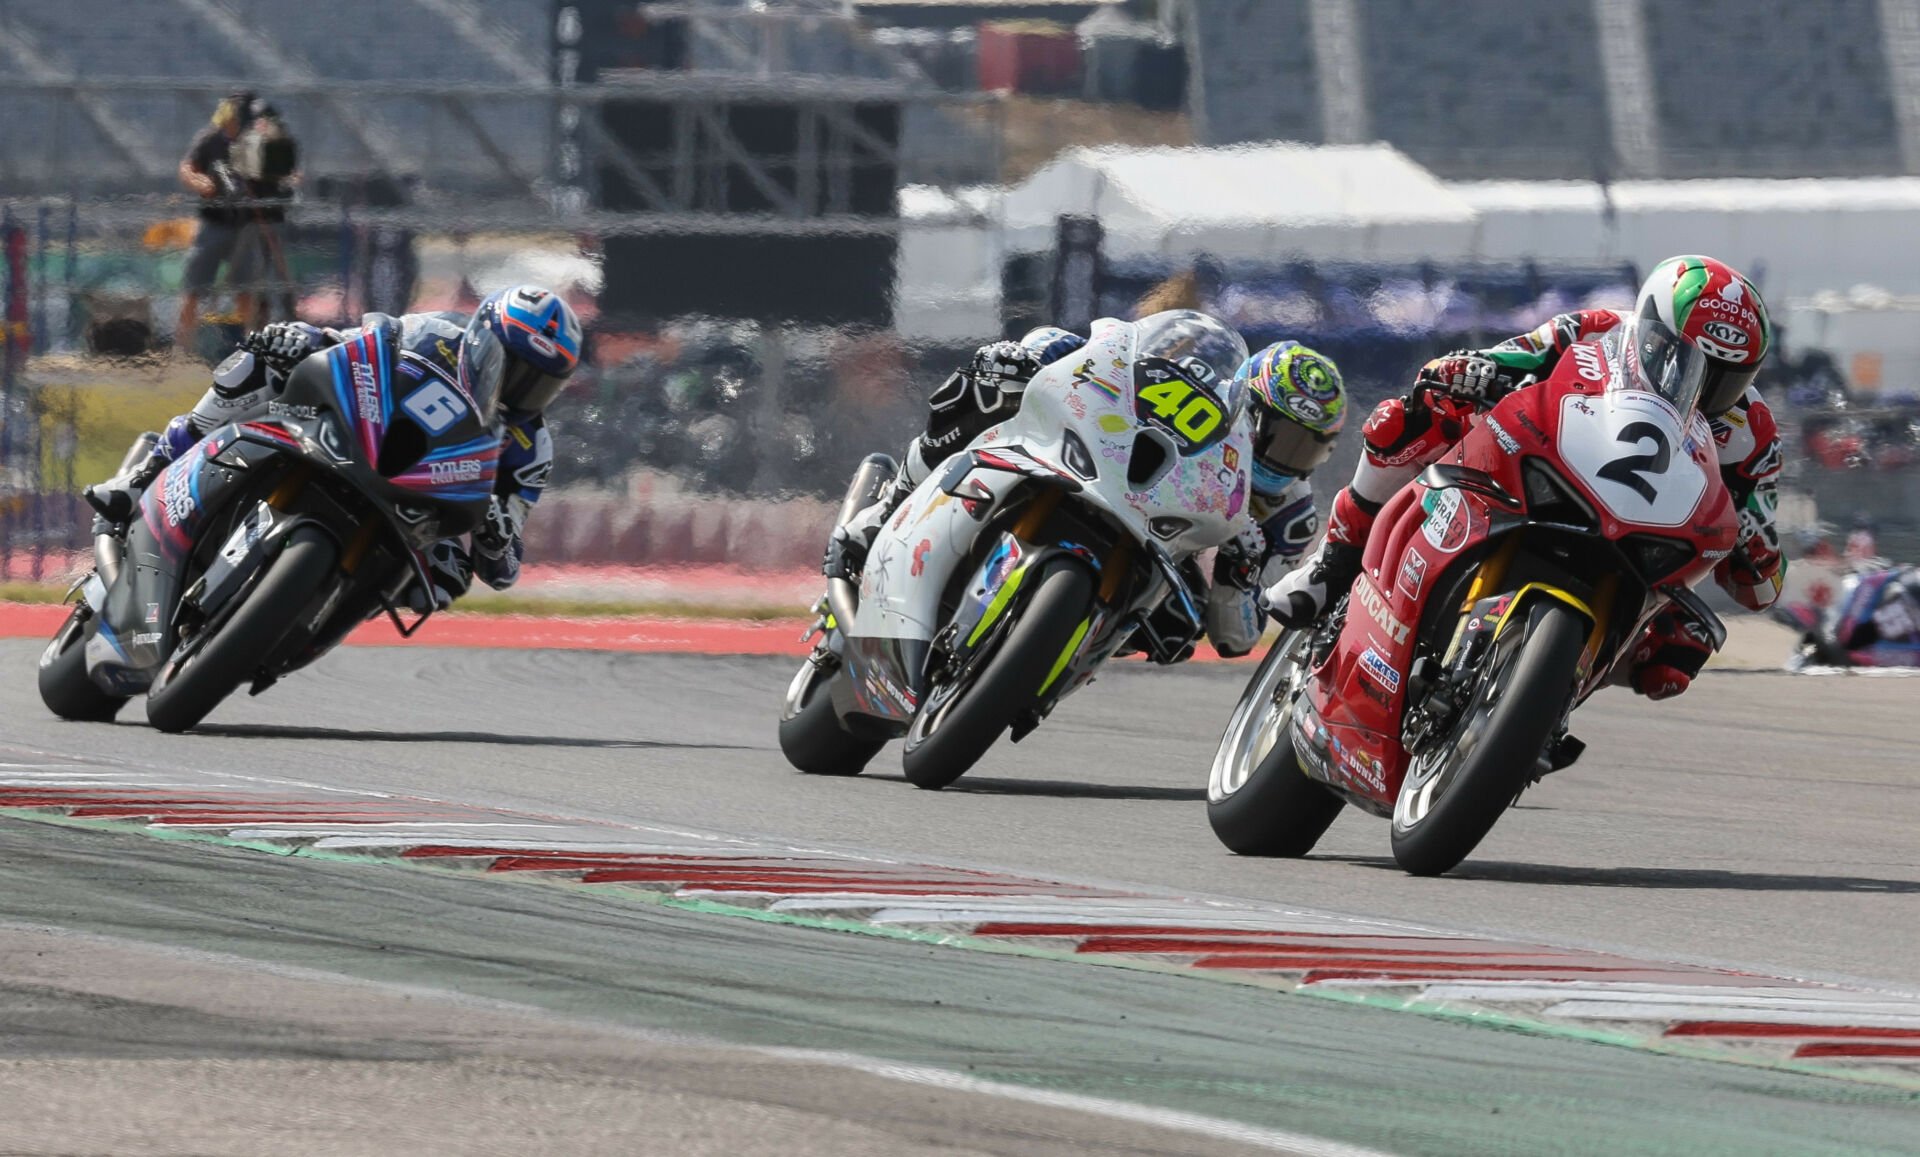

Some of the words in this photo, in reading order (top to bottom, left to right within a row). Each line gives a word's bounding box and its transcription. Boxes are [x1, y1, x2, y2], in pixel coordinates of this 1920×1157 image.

[1699, 299, 1739, 314] GOOD
[1712, 311, 1750, 330] VODKA
[1707, 322, 1745, 343] KYT
[360, 363, 381, 424] TYTLERS
[404, 381, 467, 431] 6
[1138, 380, 1222, 442] 40
[429, 459, 481, 475] TYTLERS
[1596, 421, 1671, 506] 2
[1356, 573, 1411, 646] DUCATI
[1360, 659, 1397, 691] UNLIMITED
[1363, 648, 1398, 684] PARTS
[1349, 755, 1387, 793] DUNLOP
